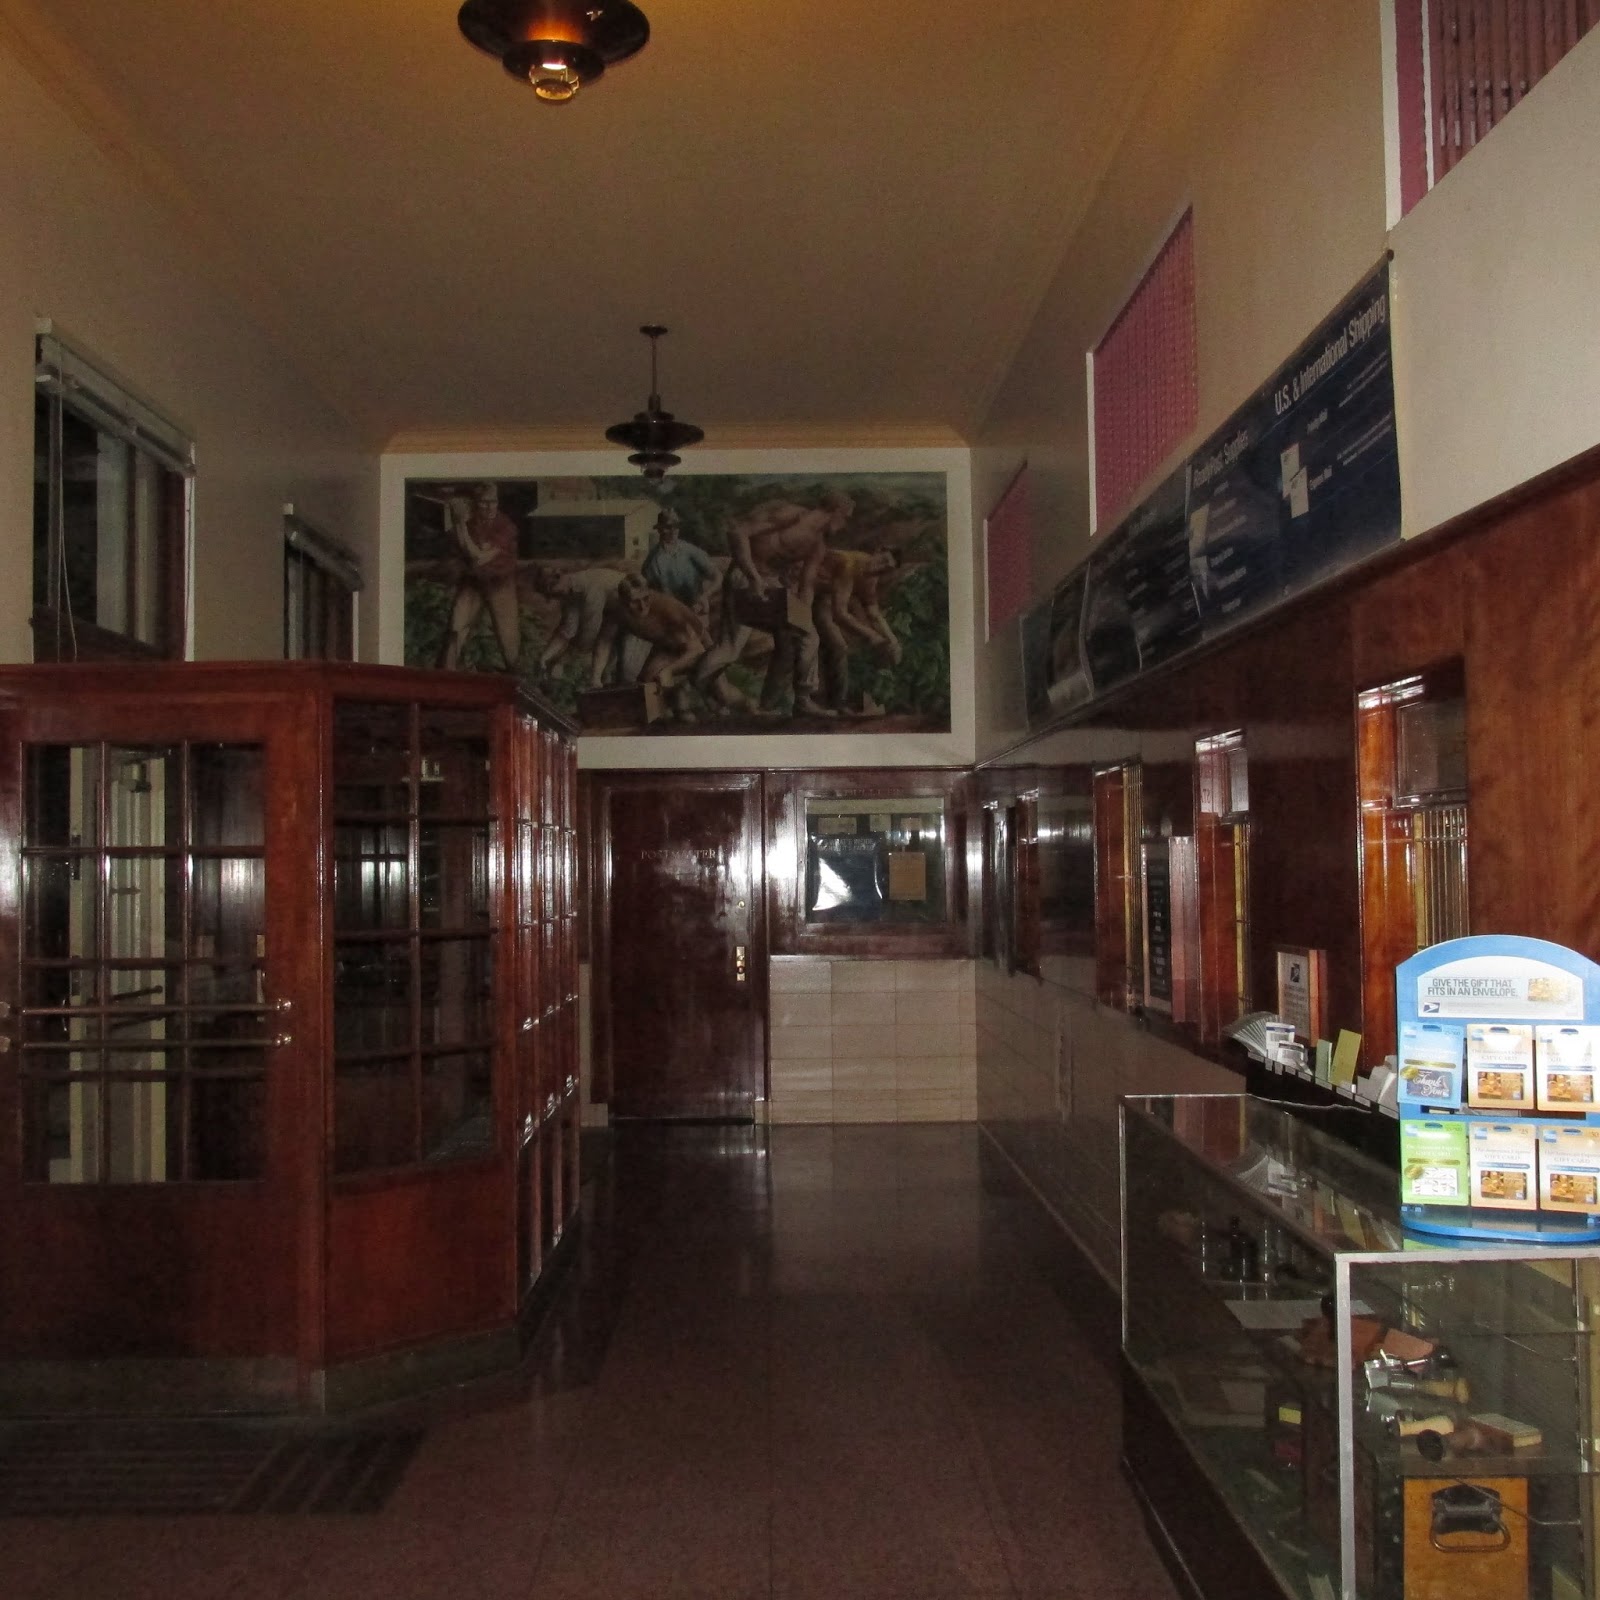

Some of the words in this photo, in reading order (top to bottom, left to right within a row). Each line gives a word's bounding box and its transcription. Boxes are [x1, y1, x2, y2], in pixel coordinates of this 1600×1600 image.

[1274, 384, 1292, 416] U.S.
[1292, 377, 1300, 402] &
[1300, 327, 1348, 394] International
[1348, 294, 1386, 347] Shipping
[640, 847, 717, 860] POSTMASTER
[1432, 978, 1452, 987] GIVE
[1453, 978, 1469, 987] THE
[1470, 979, 1489, 988] GIFT
[1490, 979, 1513, 988] THAT
[1427, 987, 1446, 996] FITS
[1447, 987, 1457, 996] IN
[1457, 987, 1471, 996] AN
[1472, 987, 1519, 997] ENVELOPE.
[1412, 1073, 1446, 1087] Thank
[1420, 1082, 1444, 1097] You
